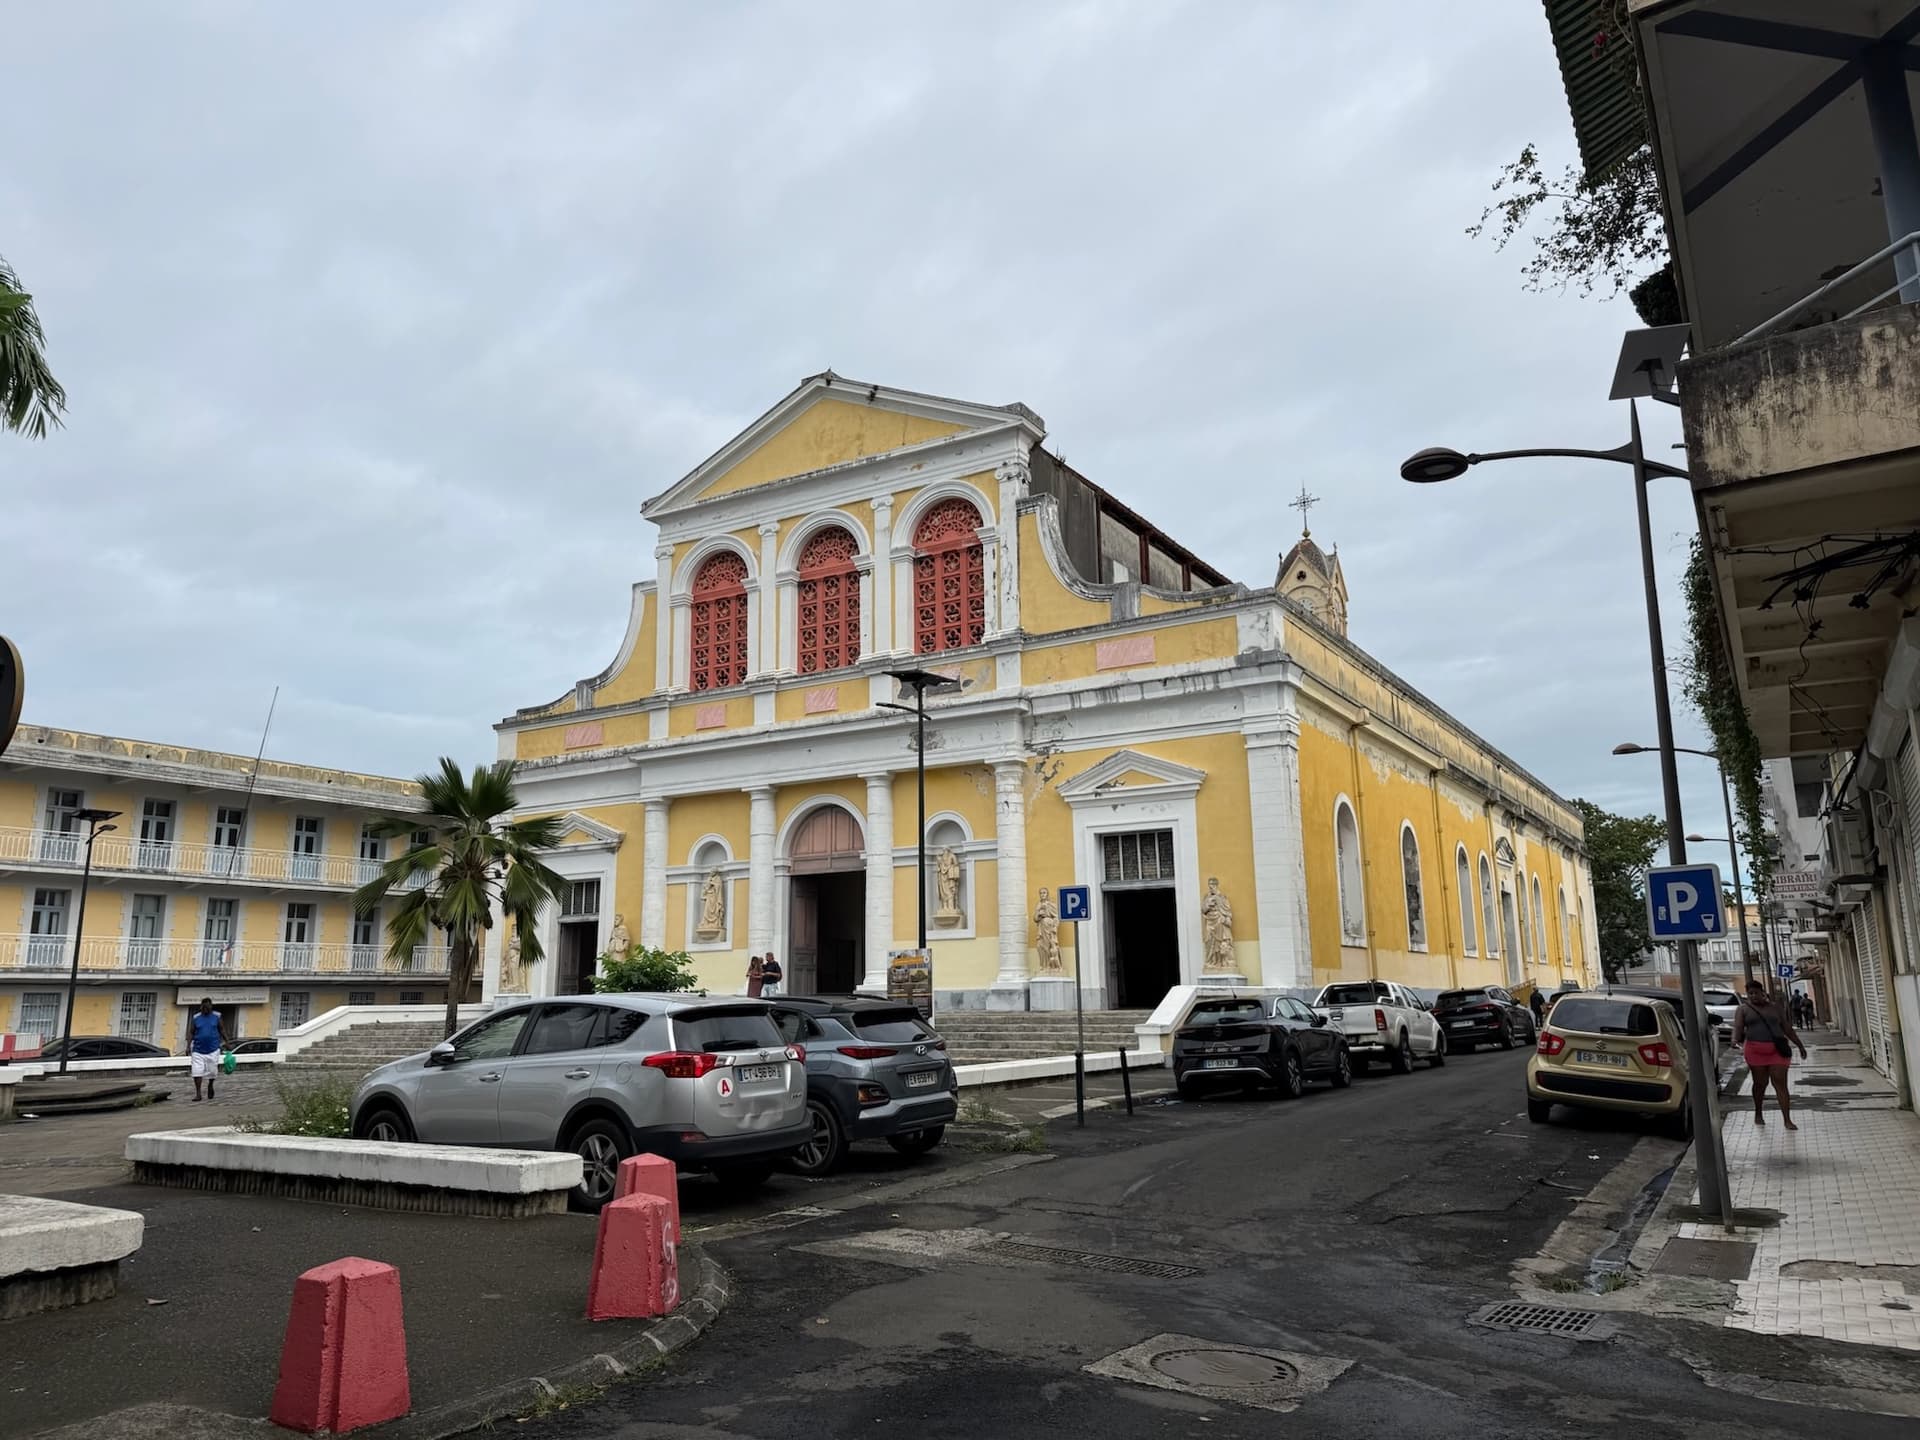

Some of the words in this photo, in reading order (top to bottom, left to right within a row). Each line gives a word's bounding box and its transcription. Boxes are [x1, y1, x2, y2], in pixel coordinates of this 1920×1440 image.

[1066, 892, 1081, 915] P
[1666, 881, 1698, 924] P
[1781, 966, 1790, 976] P
[721, 1079, 730, 1095] A
